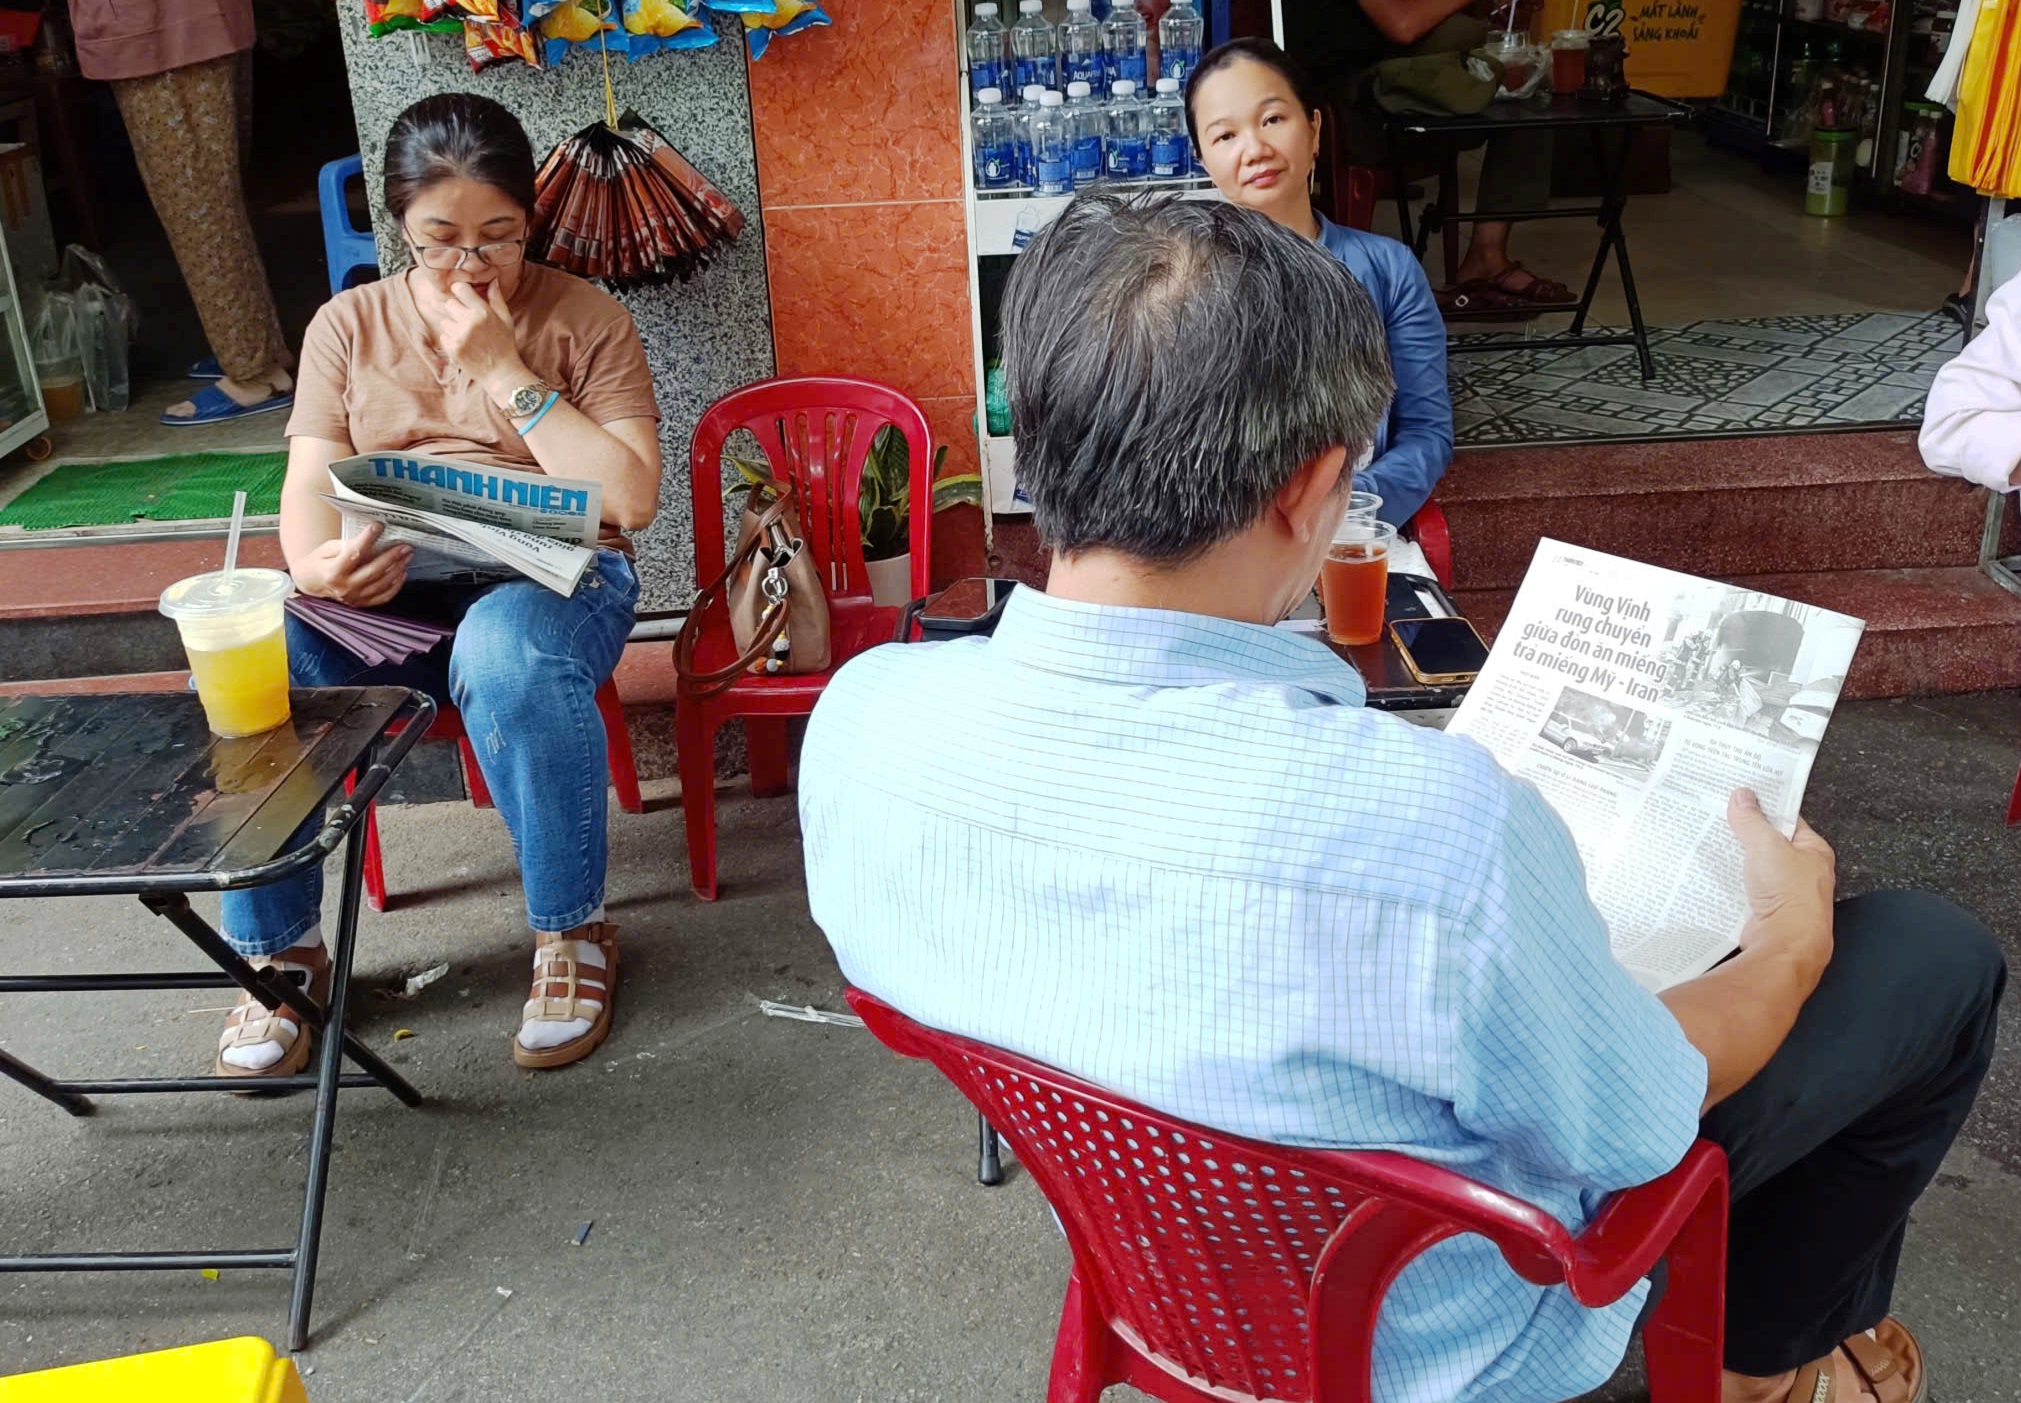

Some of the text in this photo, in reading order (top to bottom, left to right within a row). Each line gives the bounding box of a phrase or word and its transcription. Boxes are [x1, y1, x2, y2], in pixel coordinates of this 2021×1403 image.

[1584, 2, 1625, 37] C2
[368, 458, 499, 501] THANH
[502, 478, 588, 512] NIÊN
[1575, 584, 1651, 622] Vùng Vịnh
[1554, 607, 1652, 648] rung chuyển
[1512, 641, 1538, 662] trả
[1536, 651, 1590, 684] miếng
[1589, 666, 1617, 693] Mỹ
[1625, 677, 1659, 703] Iran
[1521, 620, 1667, 684] giữa đòn ăn miếng
